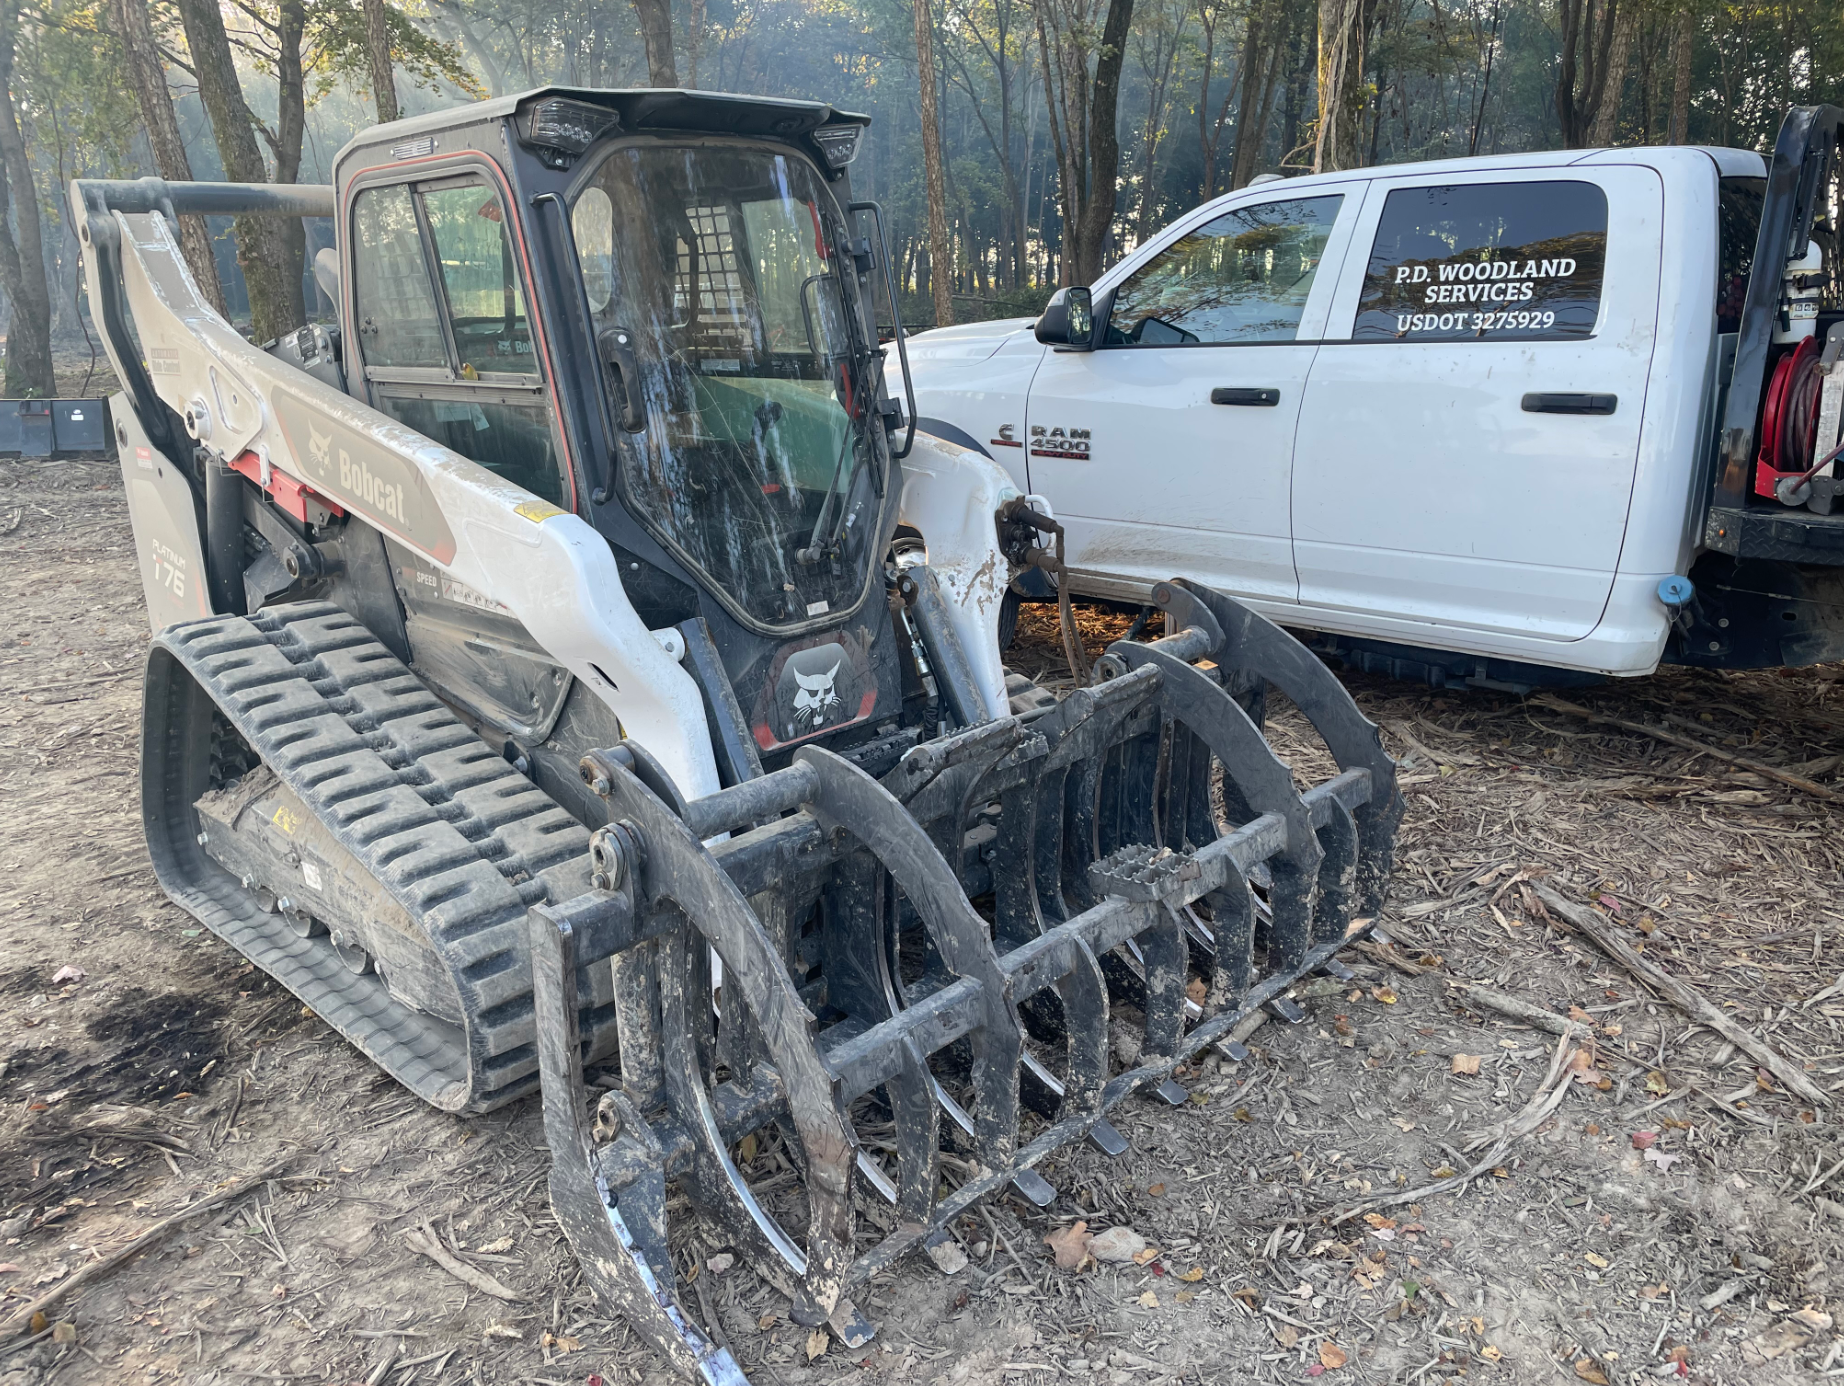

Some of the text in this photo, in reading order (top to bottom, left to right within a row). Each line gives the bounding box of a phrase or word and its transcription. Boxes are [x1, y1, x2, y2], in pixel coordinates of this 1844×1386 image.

[1395, 258, 1577, 284] P.D. WOODLAND
[1424, 281, 1535, 304] SERVICES
[1397, 311, 1555, 331] USDOT 3275929
[1031, 425, 1091, 440] RAM
[1030, 438, 1091, 452] 4500
[339, 448, 405, 524] Bobcat
[152, 538, 186, 570] PLATINUM
[152, 553, 186, 598] T76
[416, 571, 437, 587] SPEED
